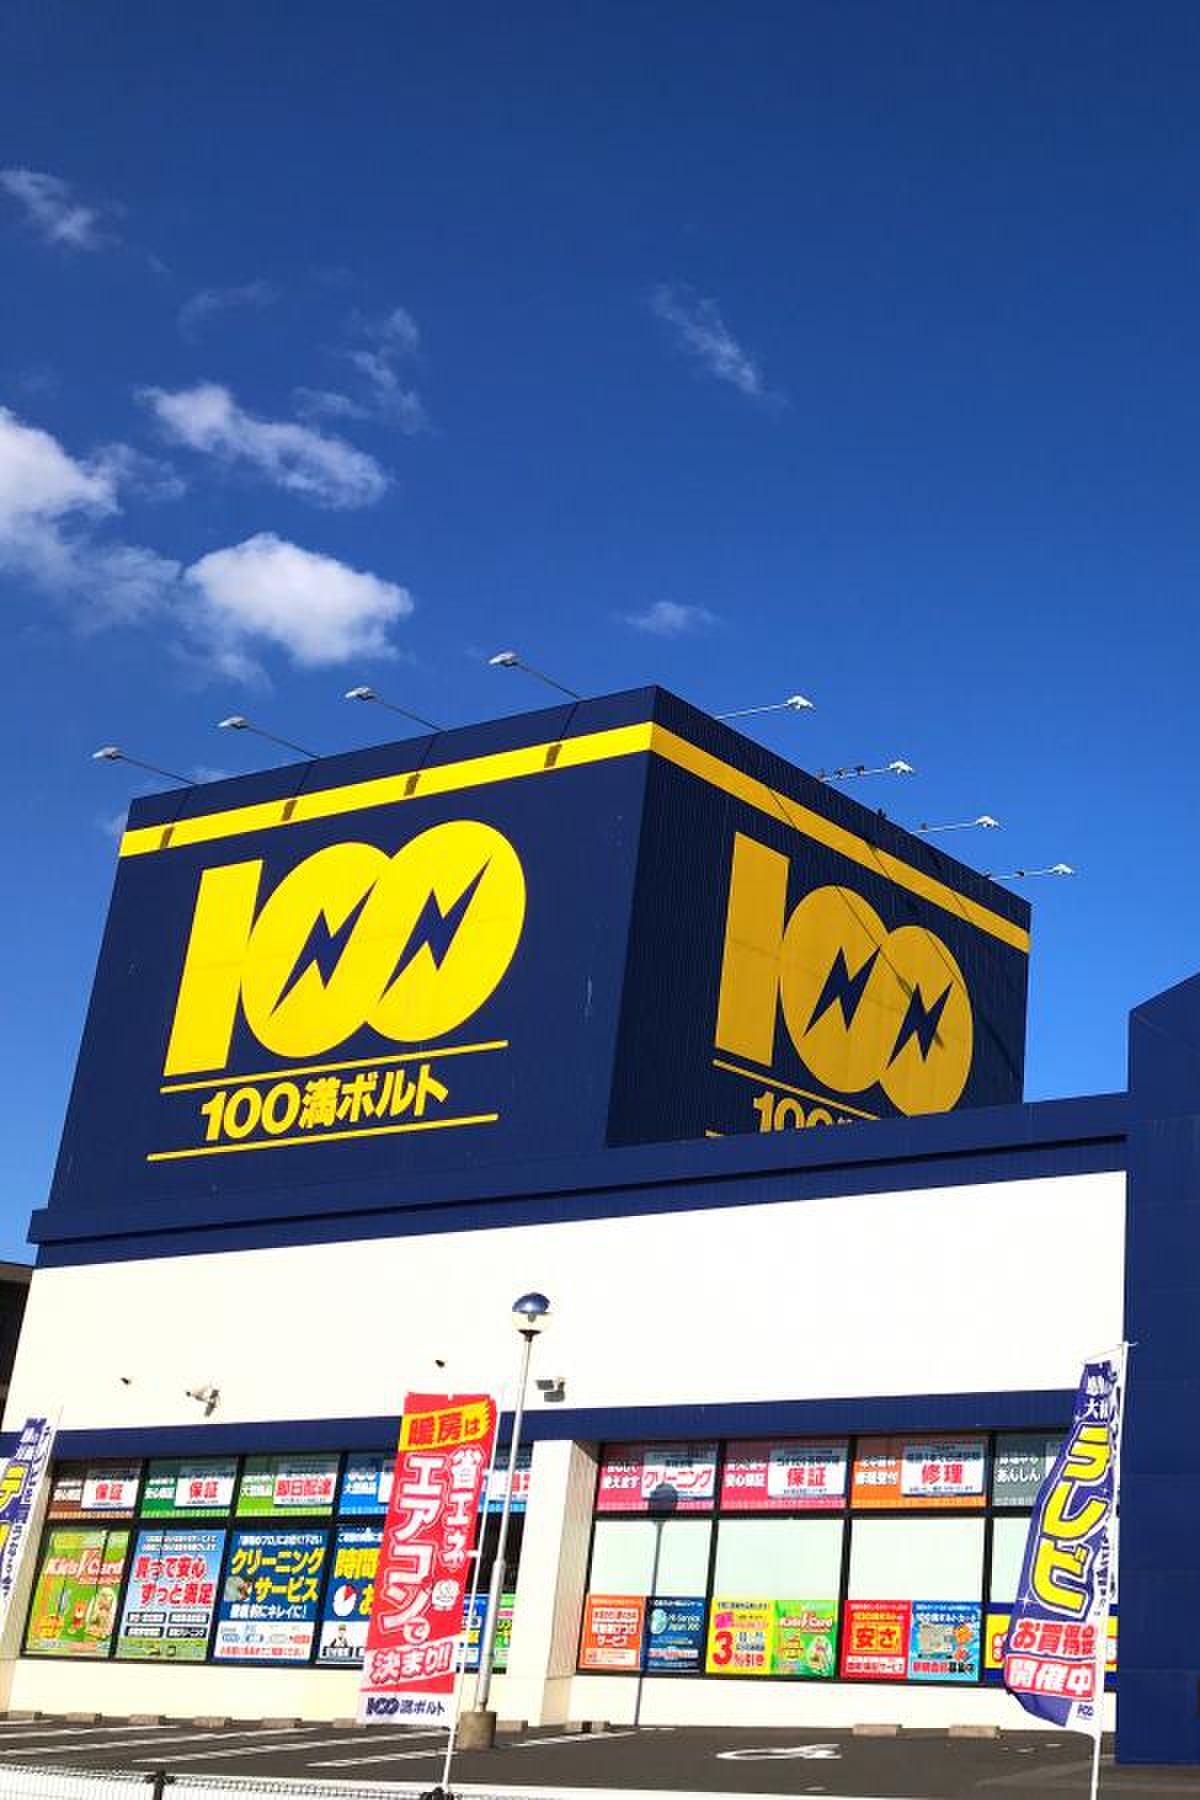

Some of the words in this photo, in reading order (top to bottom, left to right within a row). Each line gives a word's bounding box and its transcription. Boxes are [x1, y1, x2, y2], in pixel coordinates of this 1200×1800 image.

[163, 820, 526, 1077] 100
[715, 831, 974, 1116] 100
[201, 1064, 449, 1141] 100満ボルト
[407, 1411, 482, 1447] 暖房は
[189, 1480, 219, 1499] 保証
[643, 1467, 713, 1489] クリーニング
[786, 1466, 827, 1488] 保証
[921, 1463, 963, 1486] 修理
[444, 1448, 483, 1566] 省エネ
[231, 1547, 325, 1575] クリーニング
[334, 1547, 380, 1579] 時間
[382, 1455, 445, 1643] エアコンで
[254, 1577, 319, 1602] サービス
[712, 1631, 734, 1665] 3
[855, 1627, 897, 1649] 安さ
